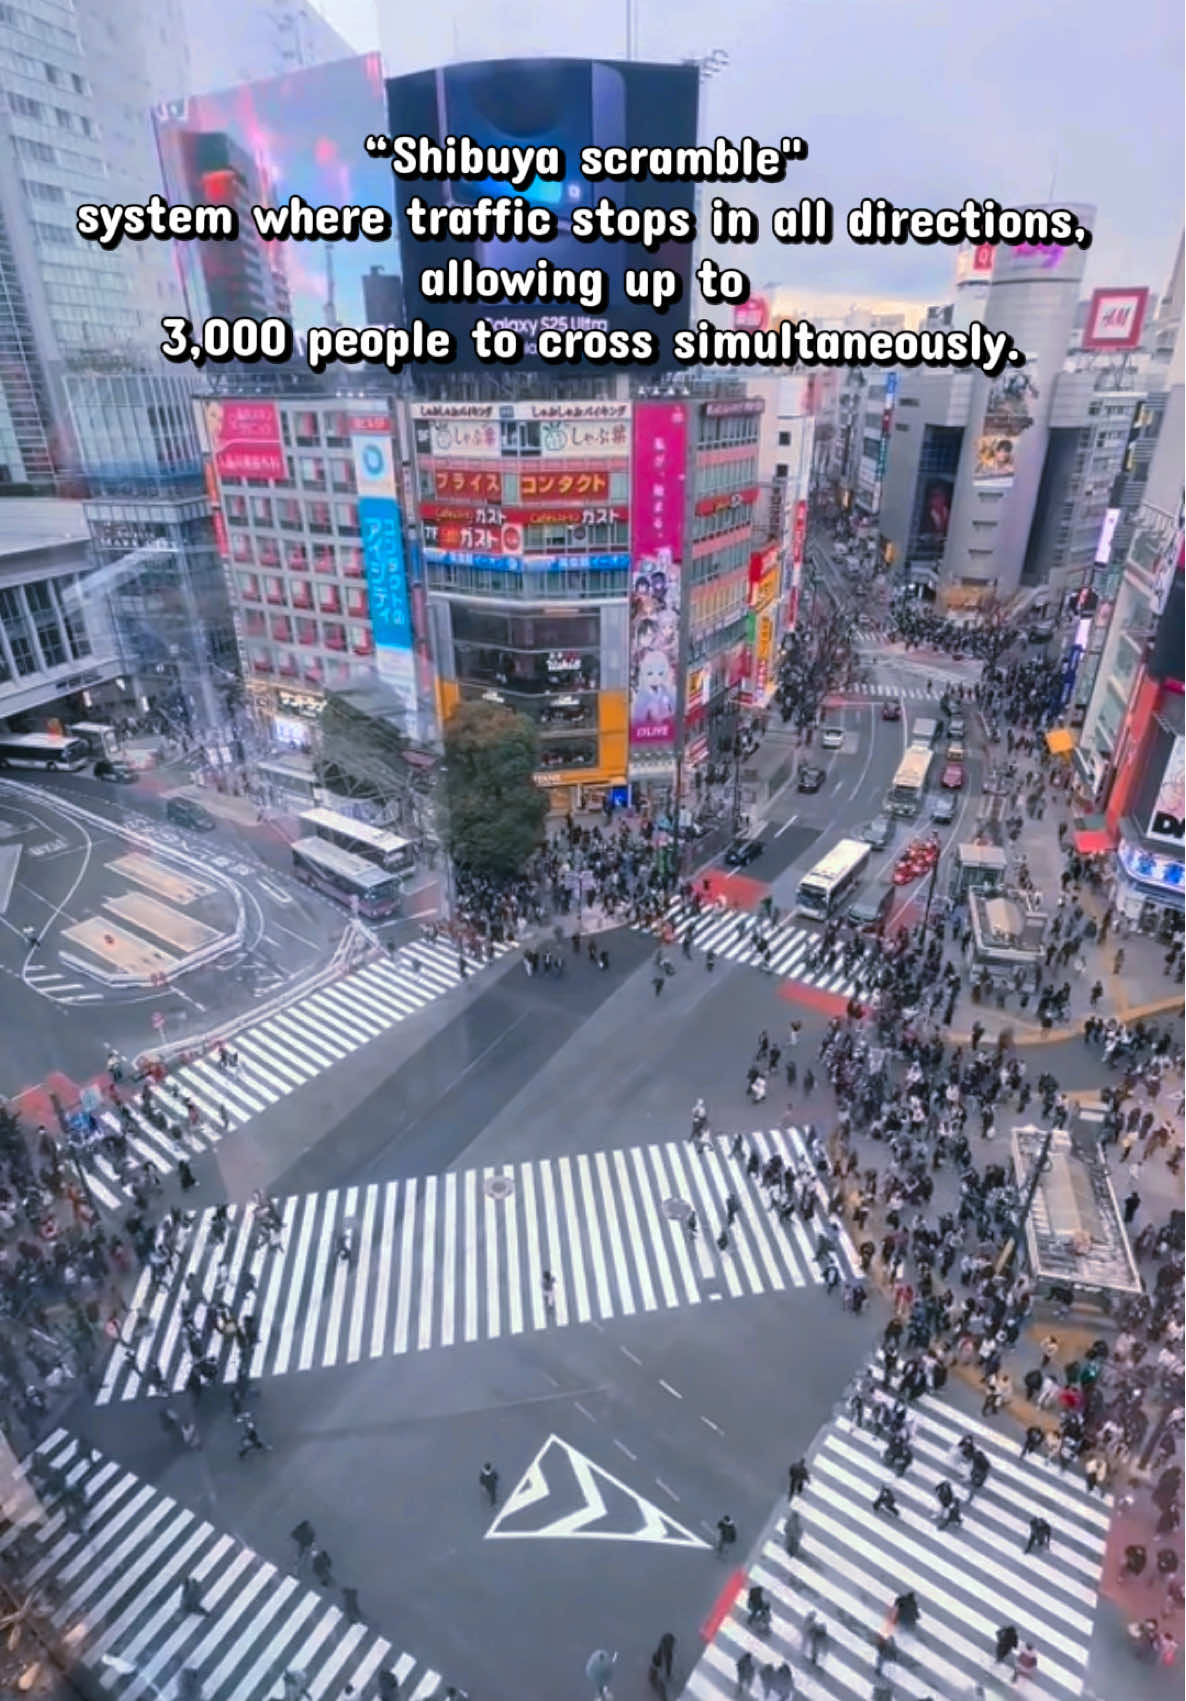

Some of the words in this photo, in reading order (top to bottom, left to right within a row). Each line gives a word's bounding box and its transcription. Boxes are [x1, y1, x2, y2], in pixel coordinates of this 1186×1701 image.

[522, 474, 606, 494] コンタクト
[460, 527, 498, 549] ガスト
